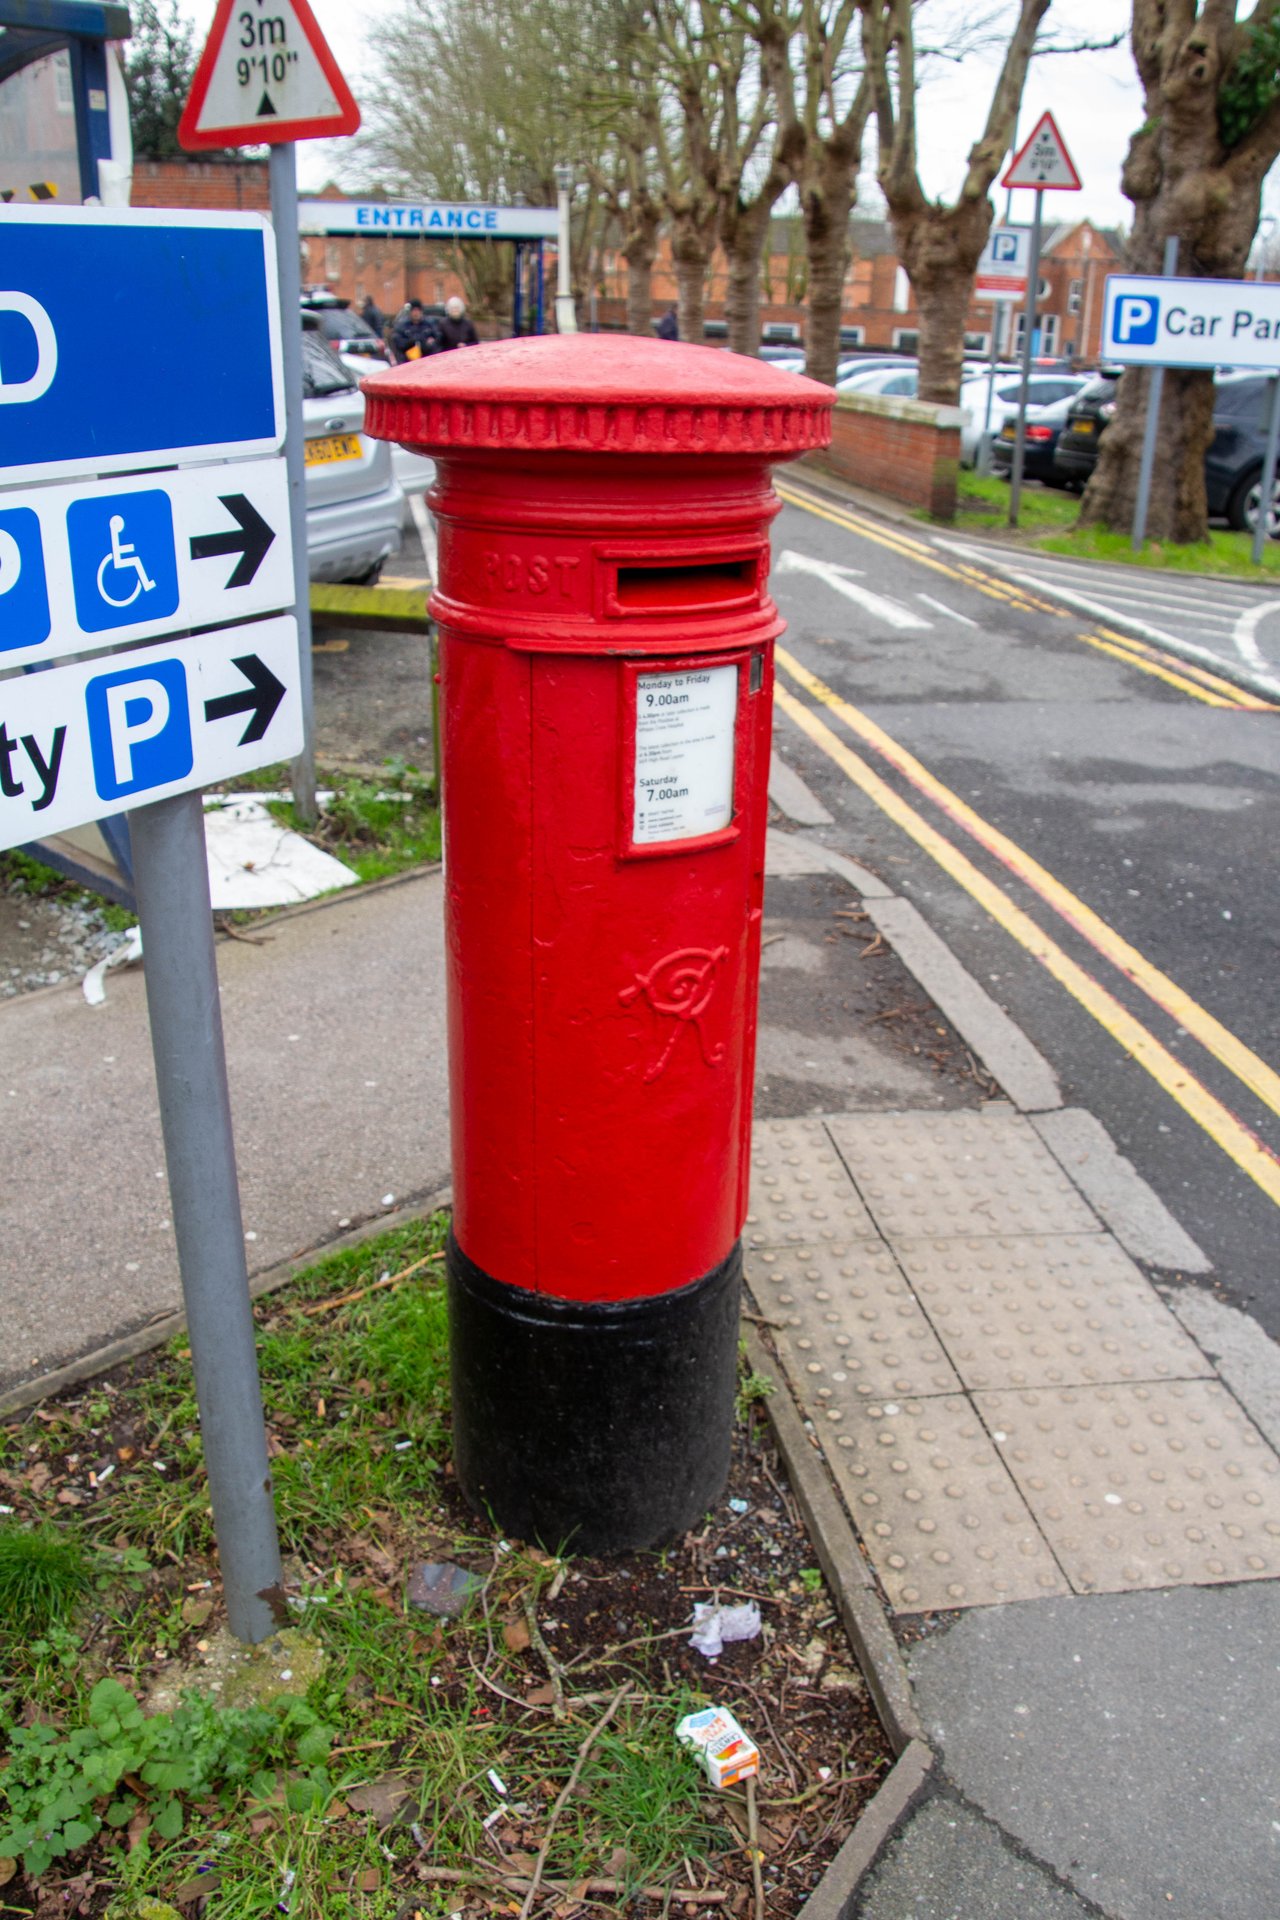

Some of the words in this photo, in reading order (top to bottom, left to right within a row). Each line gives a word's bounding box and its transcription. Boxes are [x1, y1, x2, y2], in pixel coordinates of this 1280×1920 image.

[239, 11, 286, 47] 3m
[356, 207, 498, 229] ENTRANCE
[1165, 306, 1222, 336] Car
[483, 552, 580, 597] POST
[638, 680, 672, 690] Monday
[686, 675, 710, 684] Friday
[646, 694, 689, 707] 9.00am
[639, 776, 678, 788] Saturday
[647, 788, 688, 802] 7.00am
